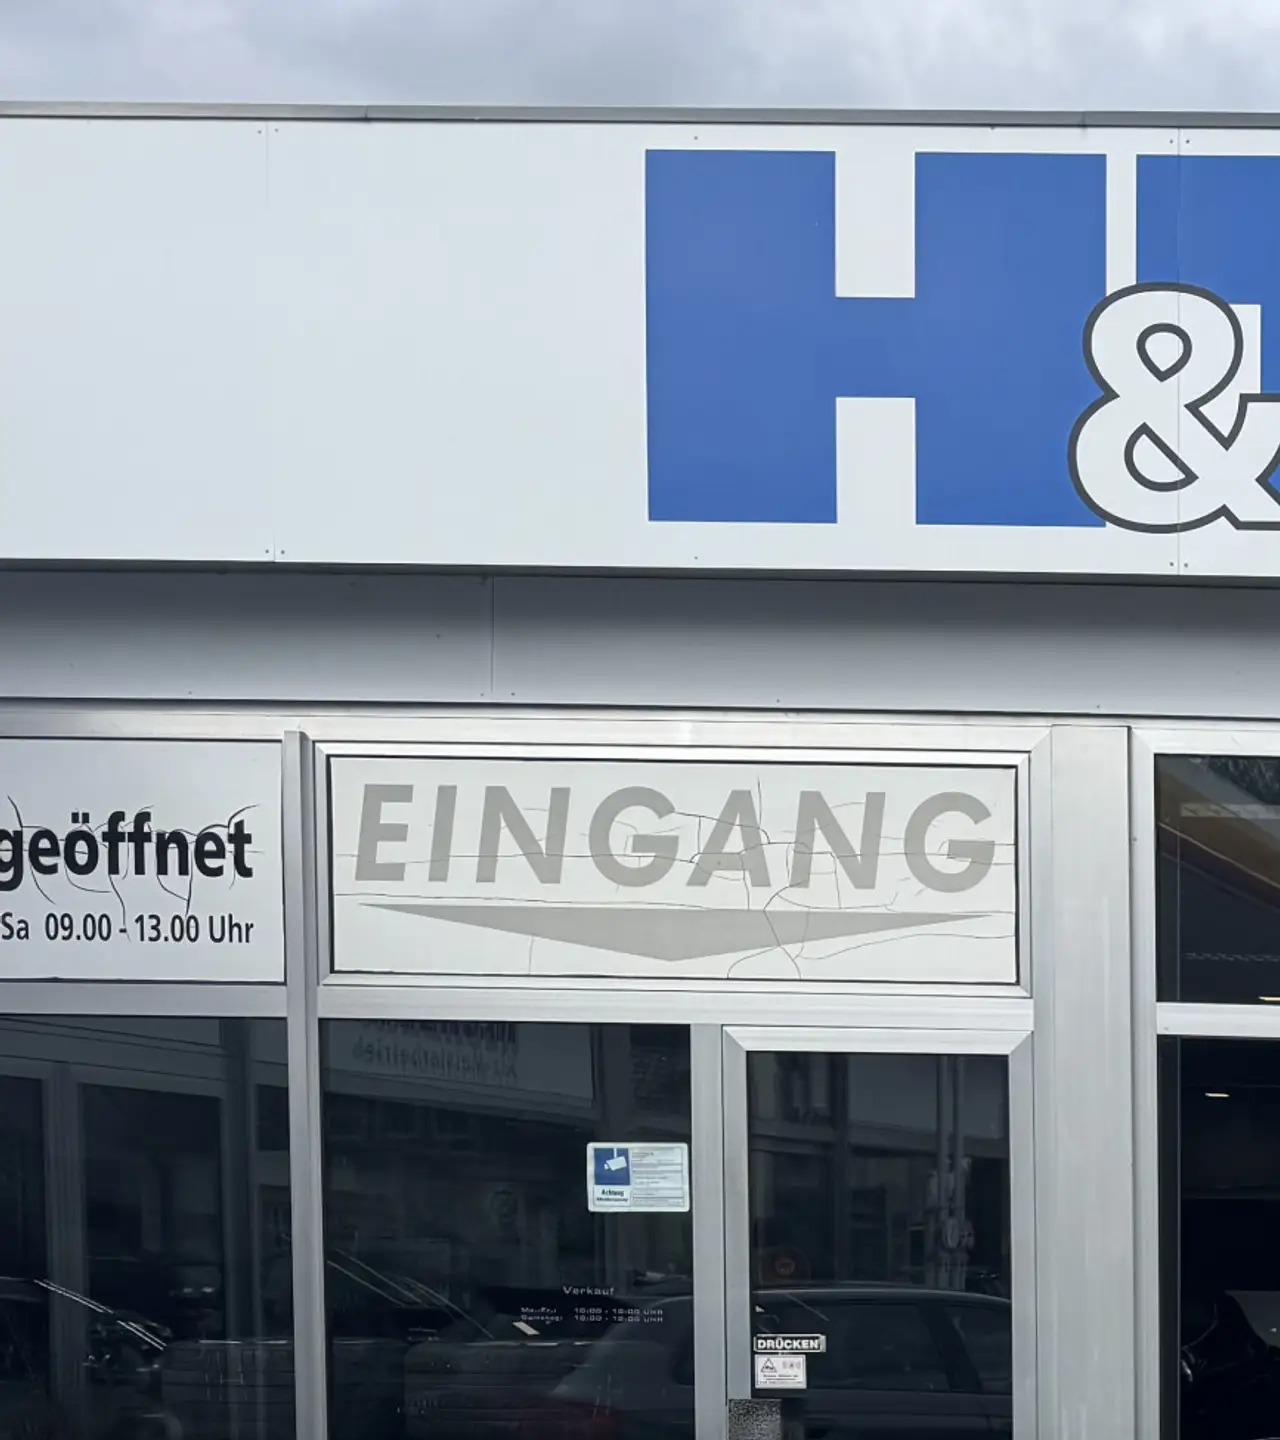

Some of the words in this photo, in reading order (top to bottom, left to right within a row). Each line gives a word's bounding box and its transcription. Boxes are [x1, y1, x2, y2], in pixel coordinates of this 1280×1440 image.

[0, 811, 254, 892] geöffnet
[355, 783, 996, 893] EINGANG
[1, 912, 29, 940] Sa
[45, 913, 112, 941] 09.00
[134, 914, 200, 943] 13.00
[209, 914, 254, 944] Uhr
[562, 1286, 615, 1296] Verkauf
[757, 1337, 819, 1350] DRÜCKEN
